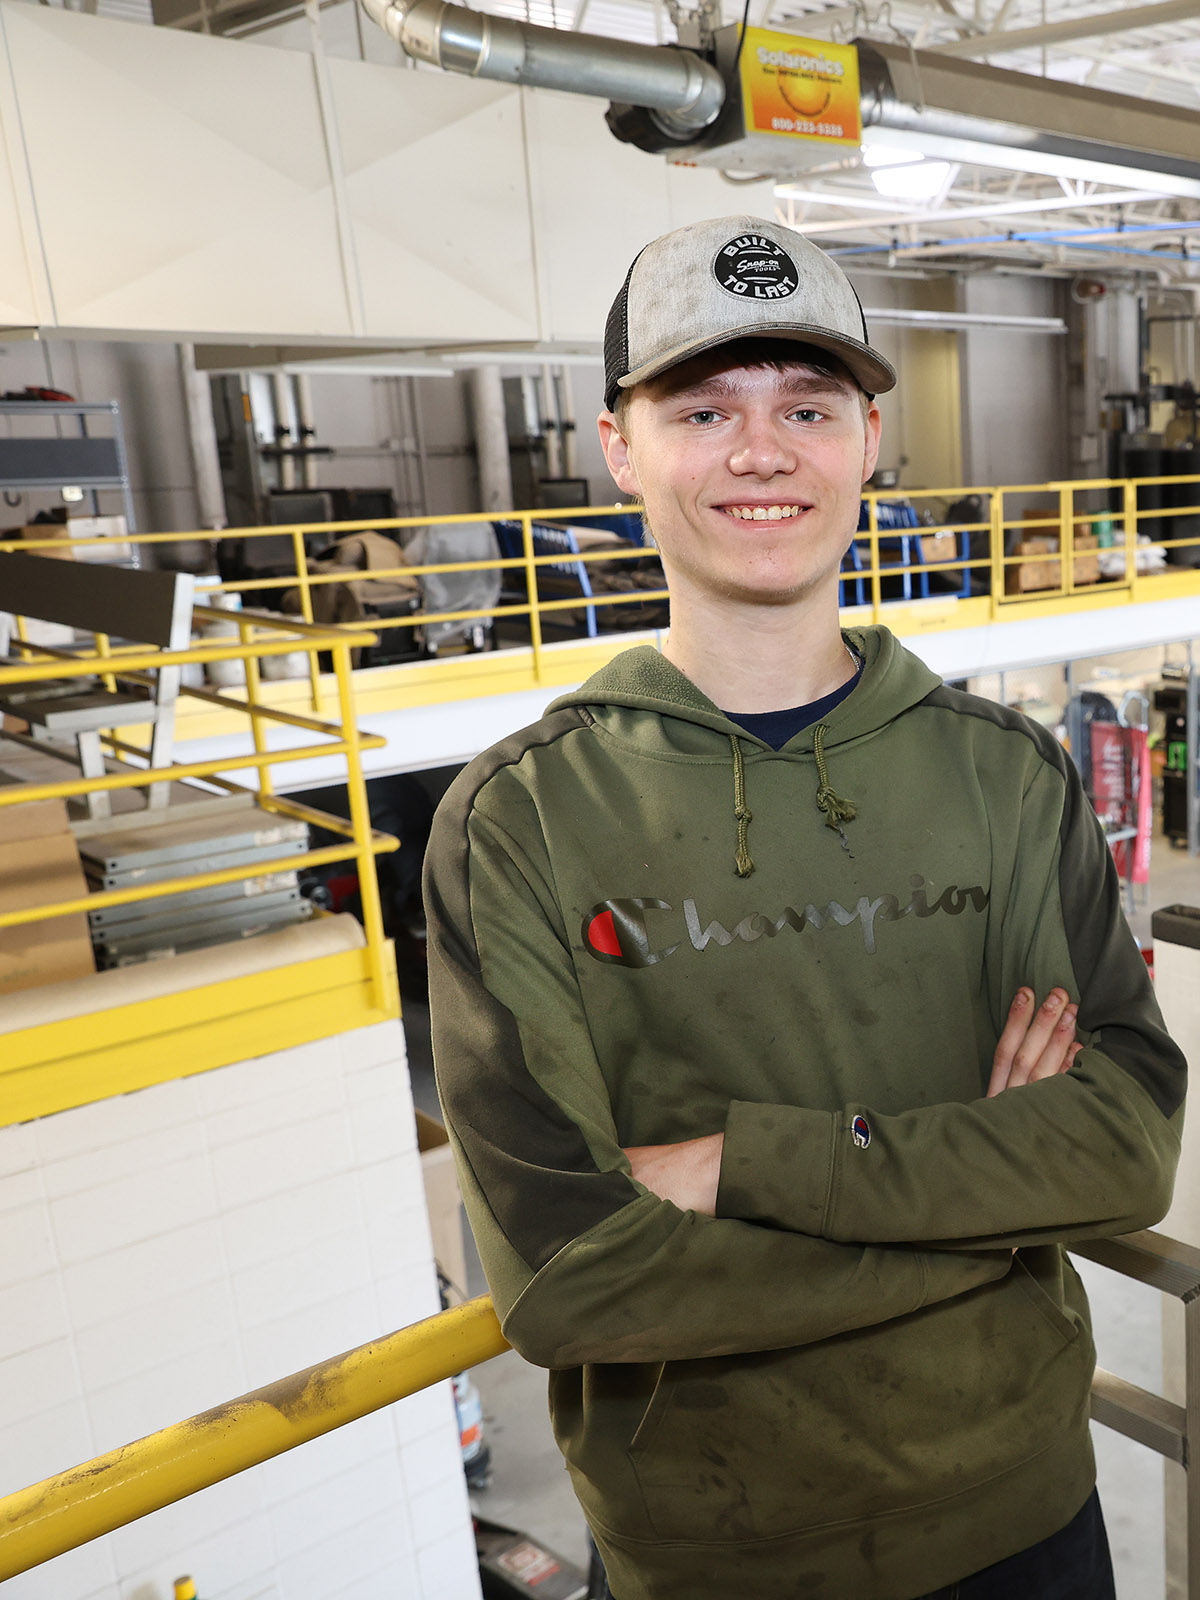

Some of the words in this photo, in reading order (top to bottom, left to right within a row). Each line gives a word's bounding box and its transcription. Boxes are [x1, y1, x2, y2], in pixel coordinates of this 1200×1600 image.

[756, 46, 845, 76] Solaronics
[723, 236, 785, 257] BUILT
[723, 274, 749, 294] TO
[754, 276, 796, 298] LAST
